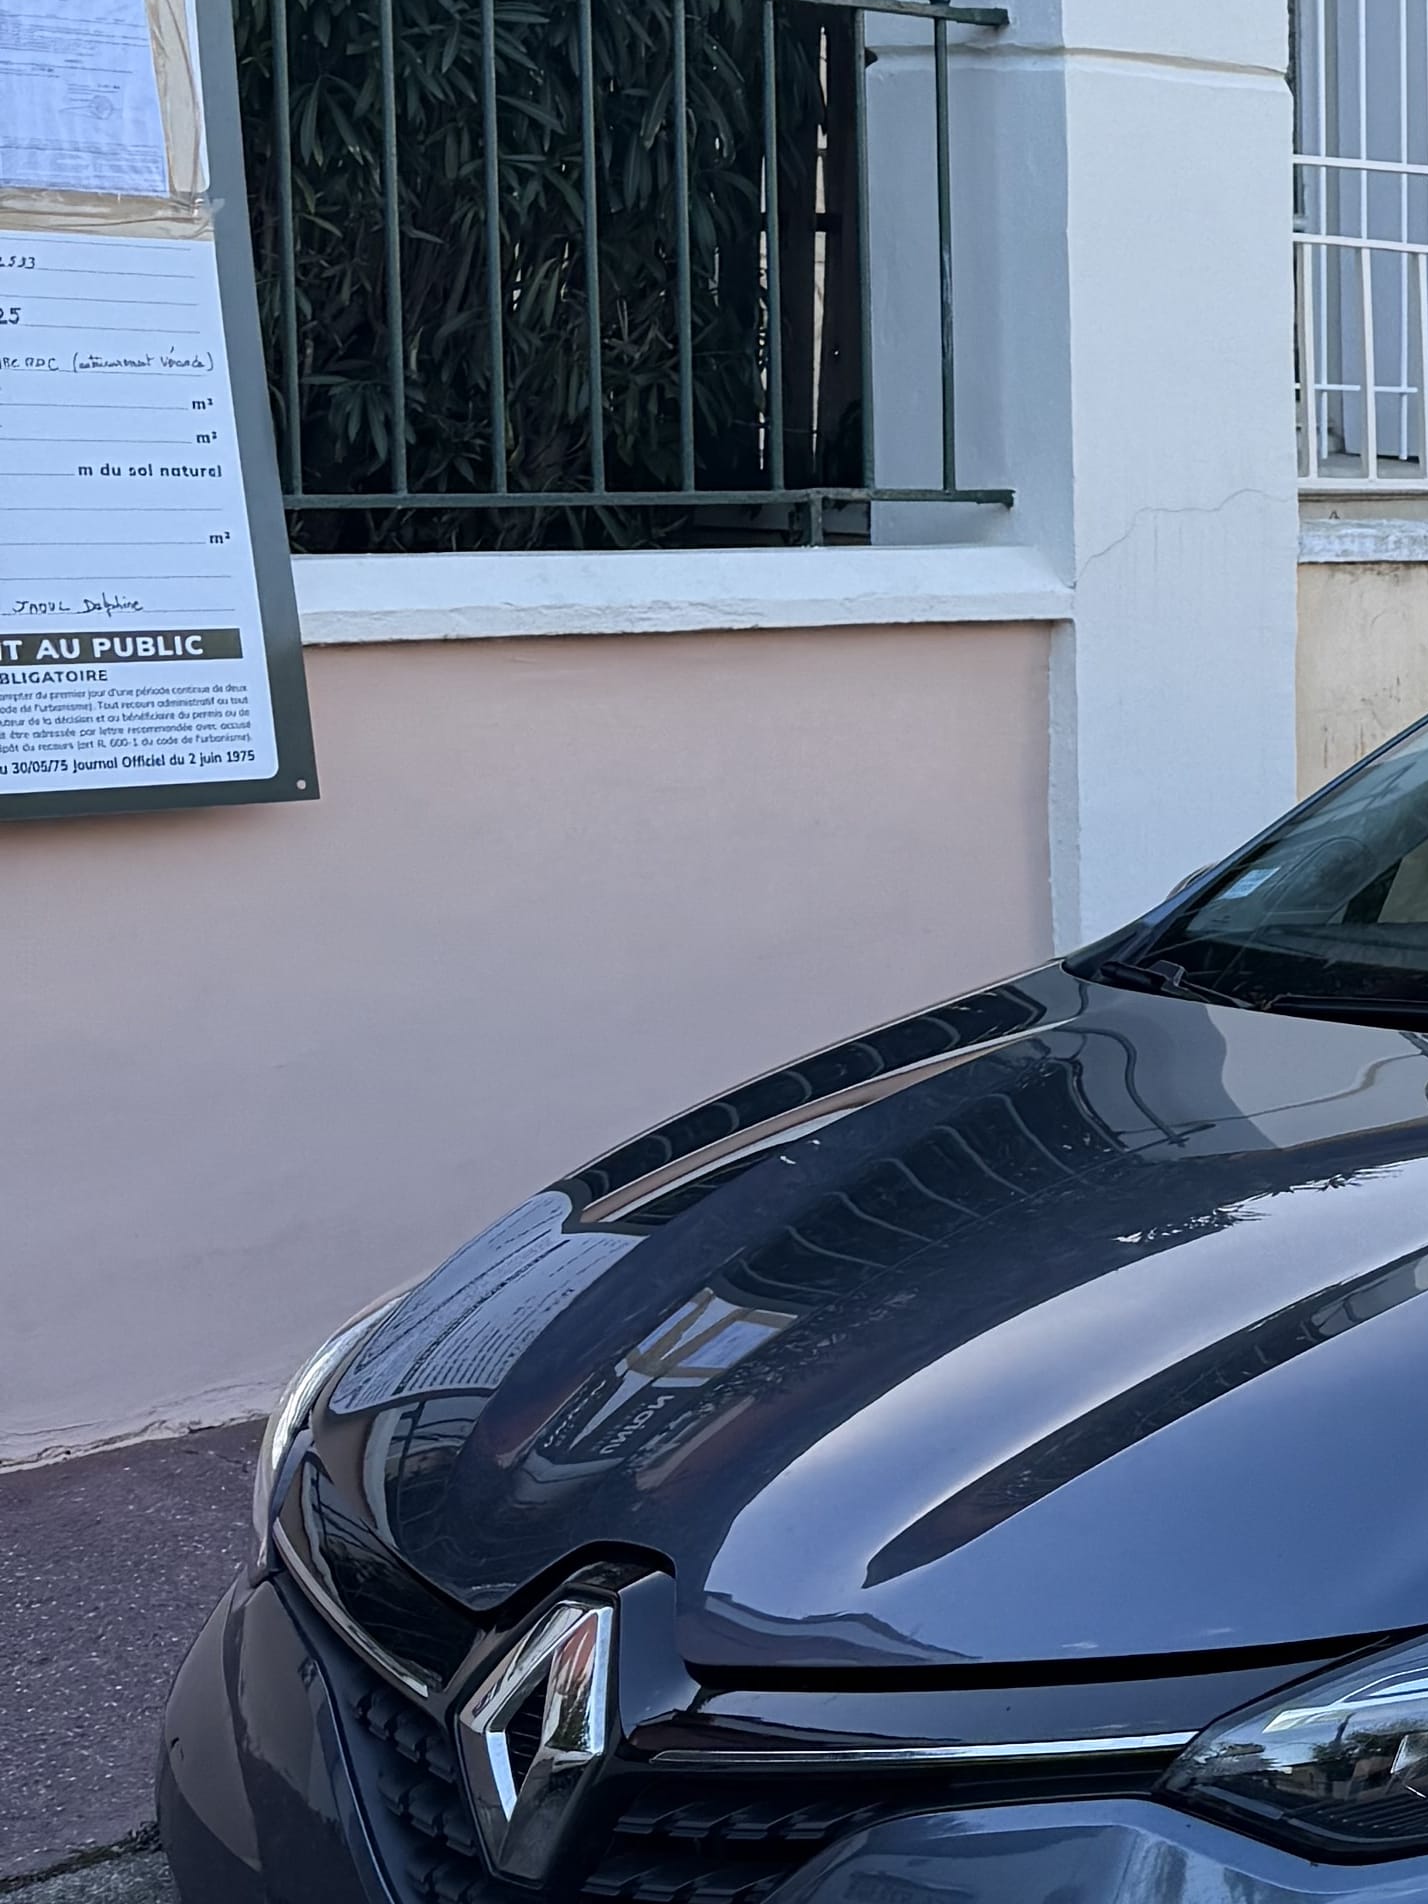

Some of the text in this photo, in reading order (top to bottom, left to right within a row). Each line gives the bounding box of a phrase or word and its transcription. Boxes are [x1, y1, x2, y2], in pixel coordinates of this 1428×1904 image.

[78, 465, 93, 476] m
[100, 463, 121, 476] du
[129, 463, 153, 477] sol
[0, 635, 203, 661] T AU PUBLIC
[11, 758, 69, 775] 30/05/75
[73, 756, 118, 774] Journal
[121, 753, 166, 769] Officiel
[169, 753, 185, 766] du
[188, 752, 197, 765] 2
[200, 751, 222, 767] juin
[226, 749, 256, 763] 1975
